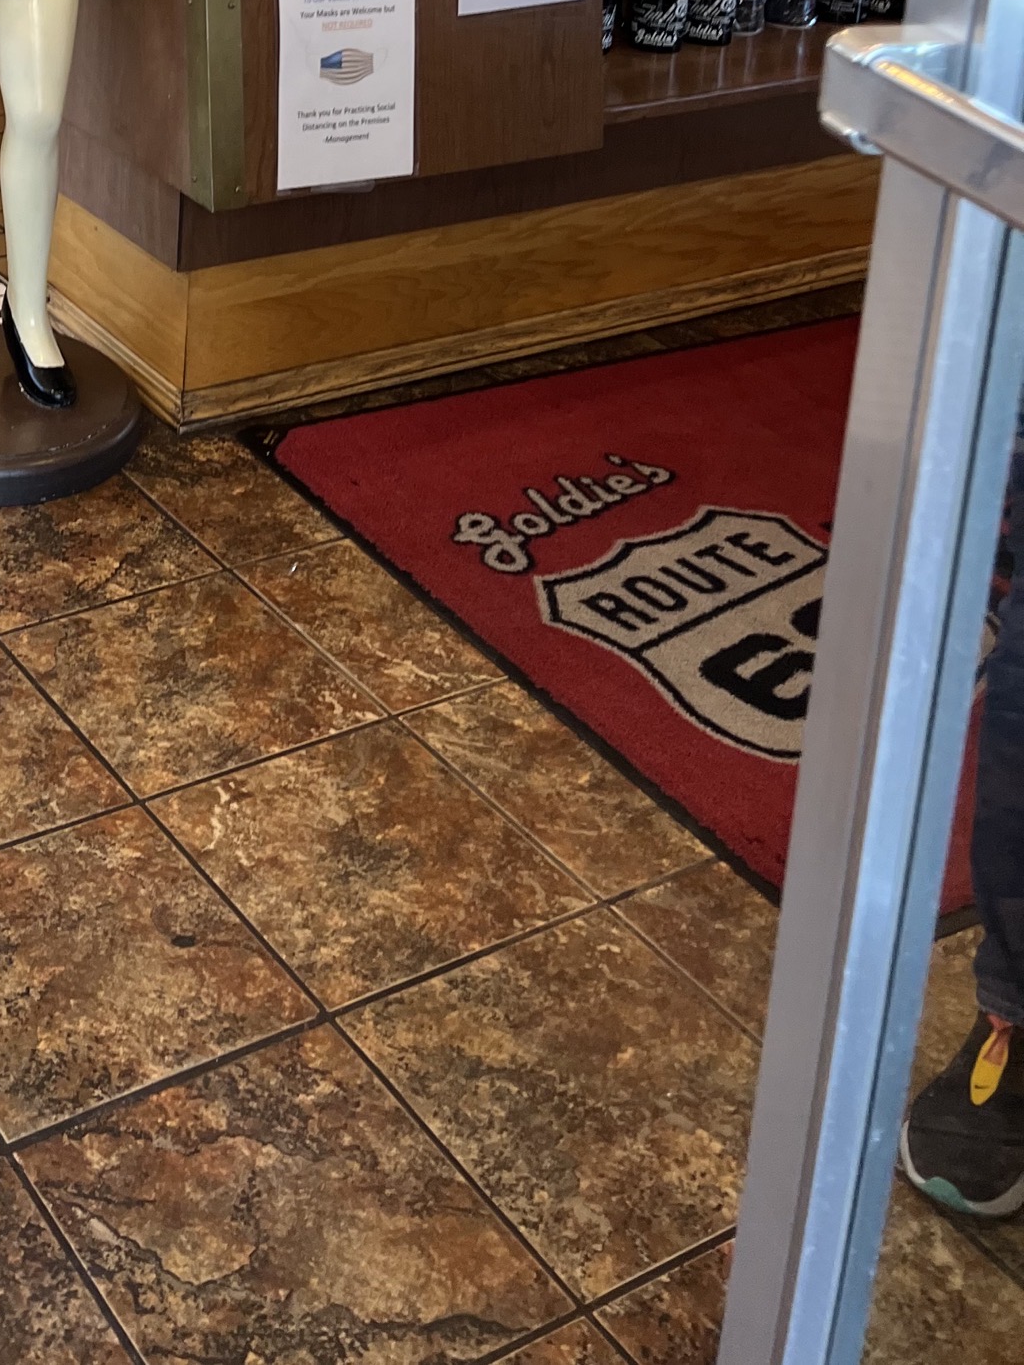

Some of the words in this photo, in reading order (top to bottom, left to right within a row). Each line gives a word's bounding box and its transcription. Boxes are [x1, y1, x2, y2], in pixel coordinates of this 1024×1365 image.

[300, 11, 315, 19] Your
[317, 9, 338, 17] Masks
[352, 6, 382, 15] Welcome
[298, 109, 317, 119] Thank
[318, 110, 331, 118] you
[332, 107, 342, 115] for
[344, 106, 375, 114] Practicing
[377, 102, 396, 111] Social
[302, 122, 336, 131] Distancing
[361, 117, 390, 125] Premises
[453, 453, 673, 573] Goldie's
[578, 533, 796, 633] ROUTE
